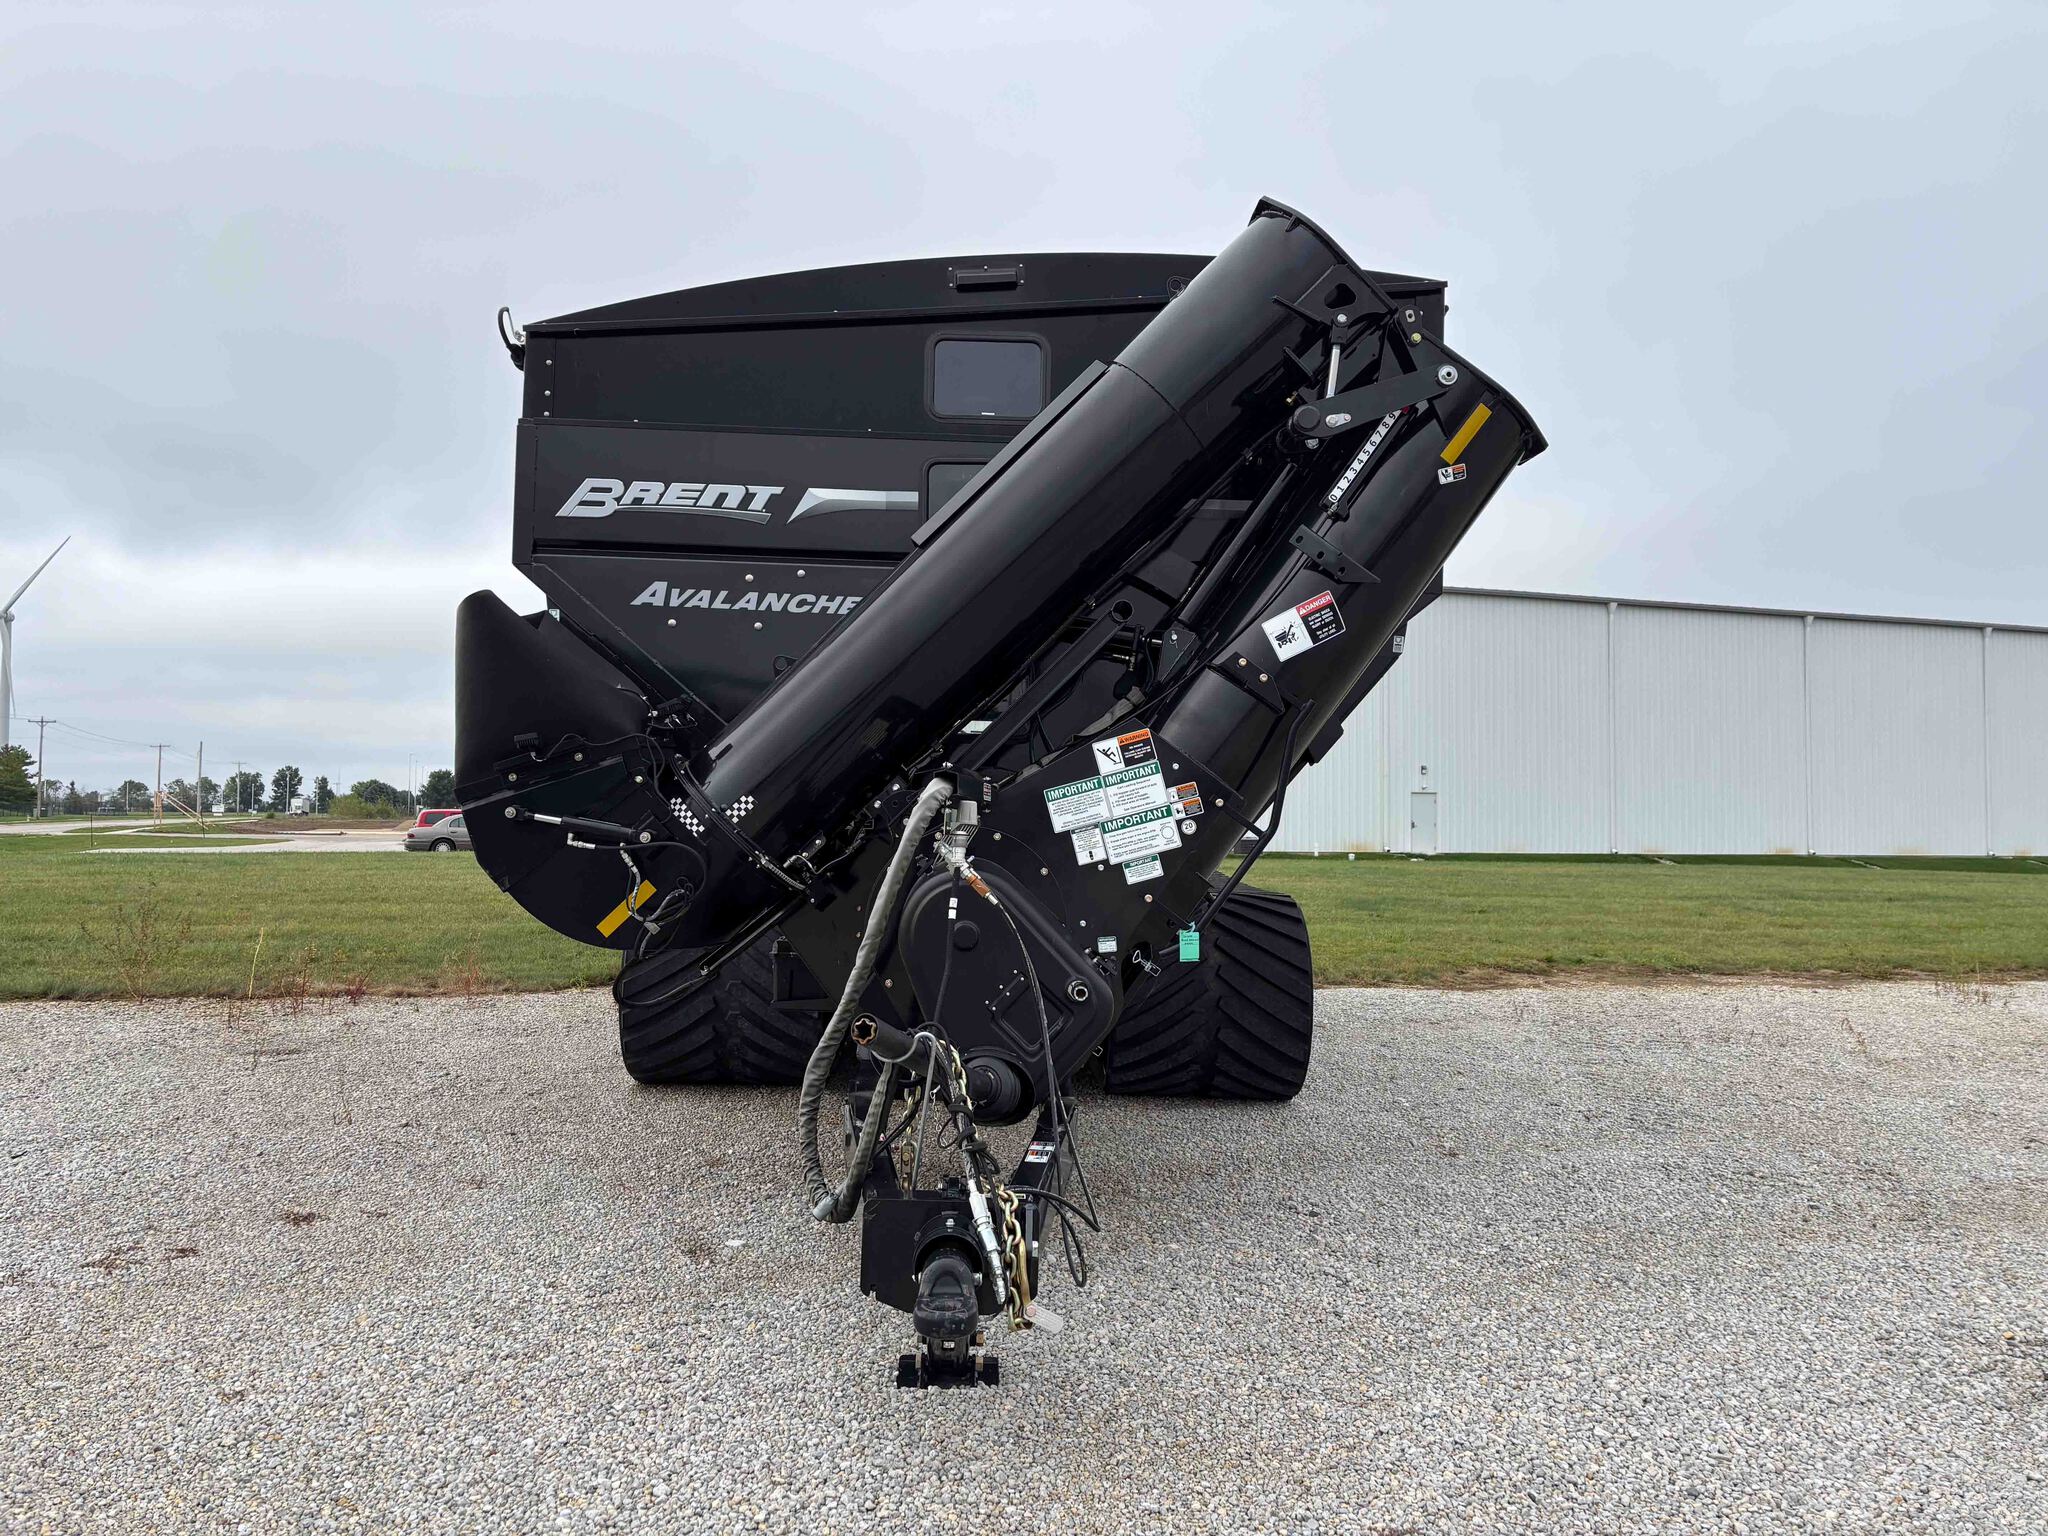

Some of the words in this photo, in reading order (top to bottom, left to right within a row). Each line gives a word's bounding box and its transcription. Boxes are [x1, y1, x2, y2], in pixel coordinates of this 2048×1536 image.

[1329, 494, 1338, 502] 0
[1336, 485, 1345, 493] 1
[1343, 476, 1351, 484] 2
[1349, 466, 1358, 475] 3
[1356, 457, 1364, 465] 4
[1363, 448, 1370, 456] 5
[1370, 439, 1377, 447] 6
[1375, 430, 1383, 438] 7
[1382, 421, 1390, 429] 8
[1389, 412, 1397, 420] 9
[555, 477, 785, 518] BRENT
[630, 581, 864, 615] AVALANCHE
[1305, 595, 1331, 611] DANGER
[1124, 732, 1150, 742] WARNING
[1105, 763, 1156, 786] IMPORTANT
[1048, 779, 1099, 801] IMPORTANT
[1103, 806, 1168, 832] IMPORTANT
[1184, 822, 1194, 830] 20
